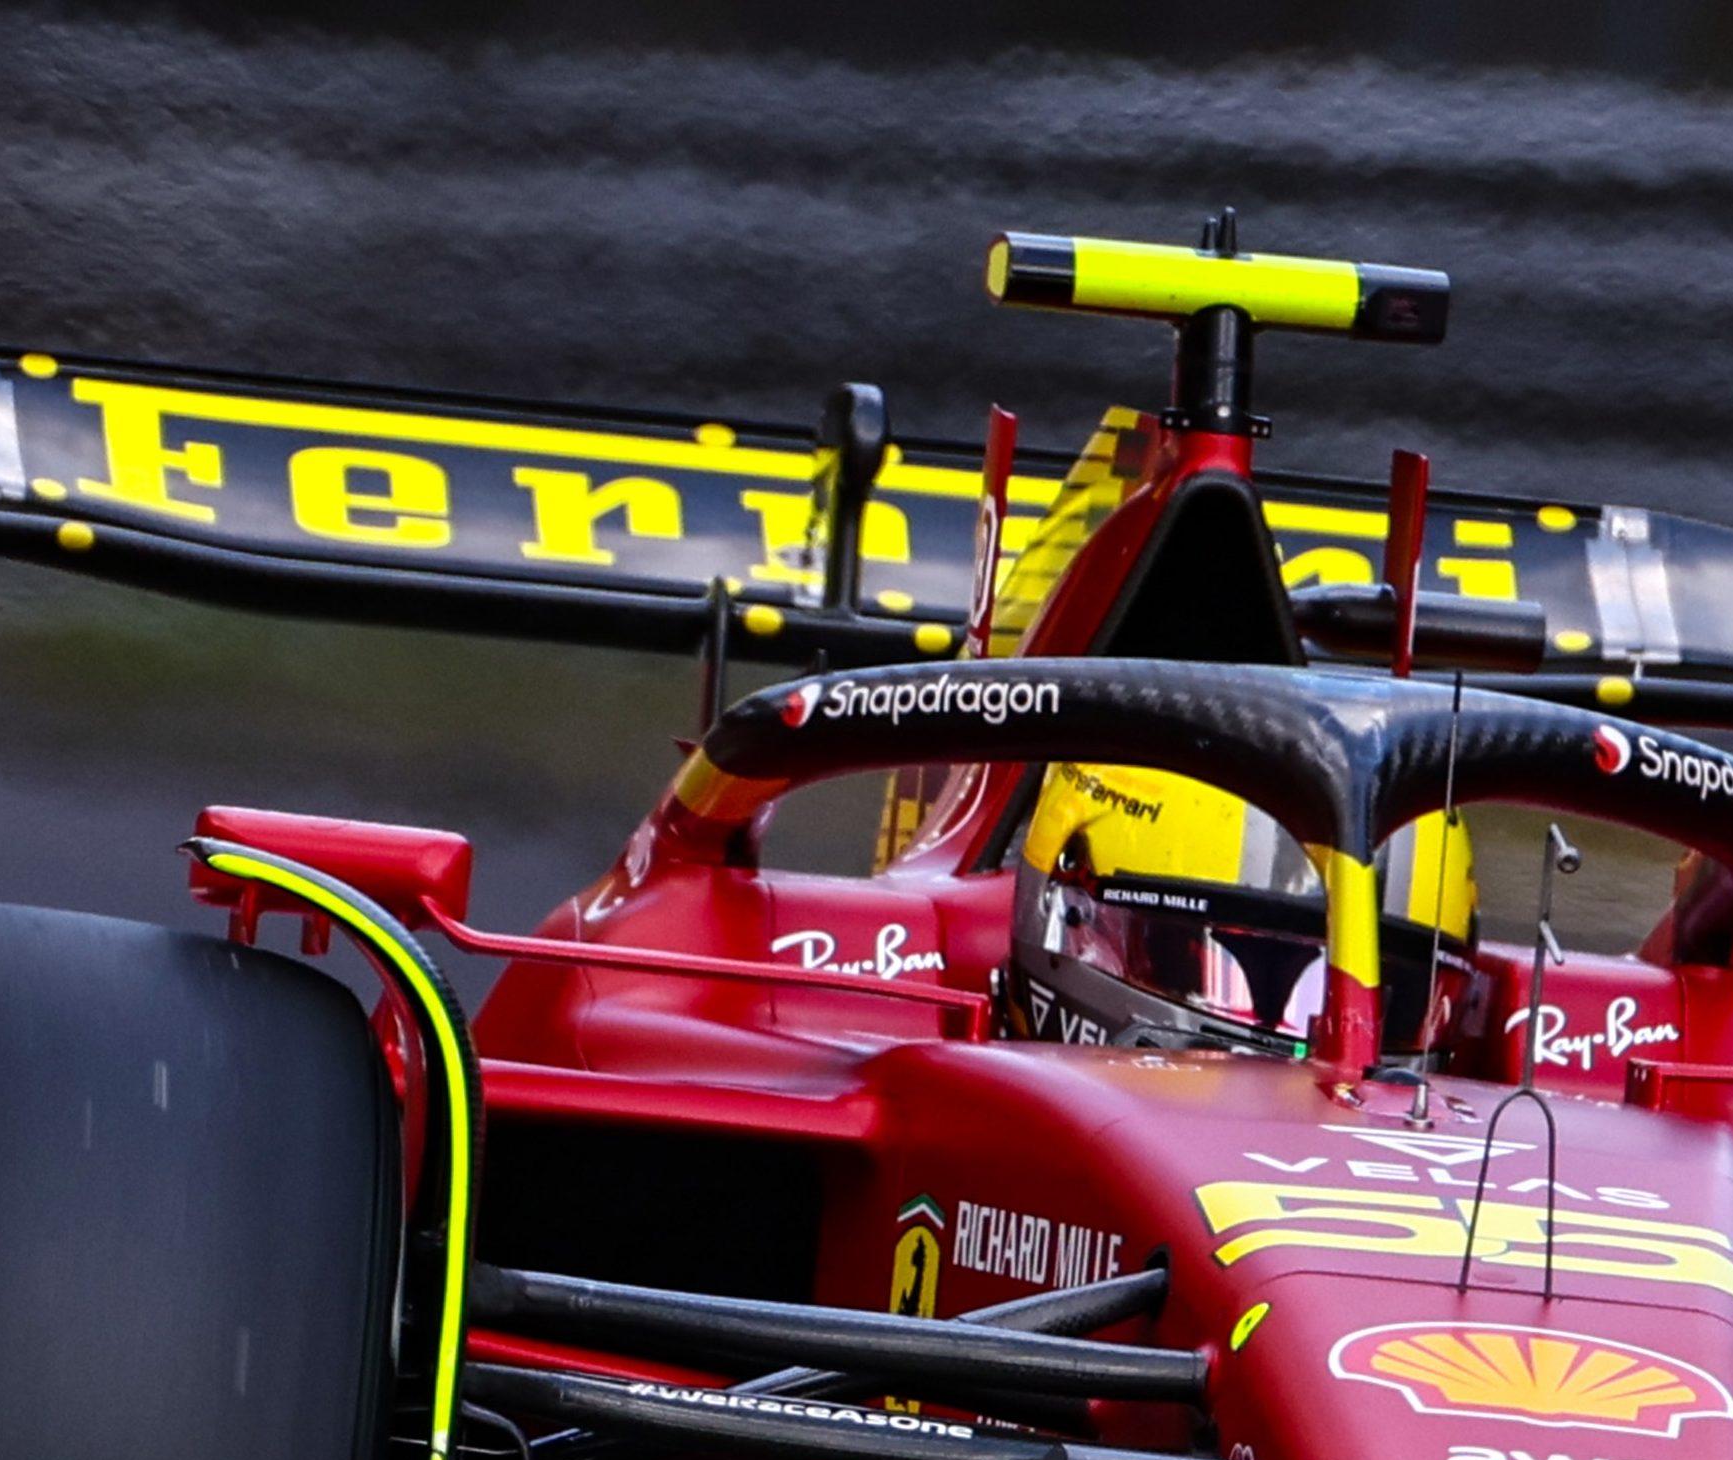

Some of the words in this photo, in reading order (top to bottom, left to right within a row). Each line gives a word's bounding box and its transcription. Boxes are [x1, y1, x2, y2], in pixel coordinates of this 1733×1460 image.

[823, 673, 1060, 725] Snapdragon
[1103, 887, 1159, 905] RICHARD
[1163, 894, 1208, 912] MILLE
[1243, 1151, 1671, 1210] VELAS
[953, 1200, 1051, 1285] RICHARD
[628, 1382, 974, 1440] #WeRaceAsOne
